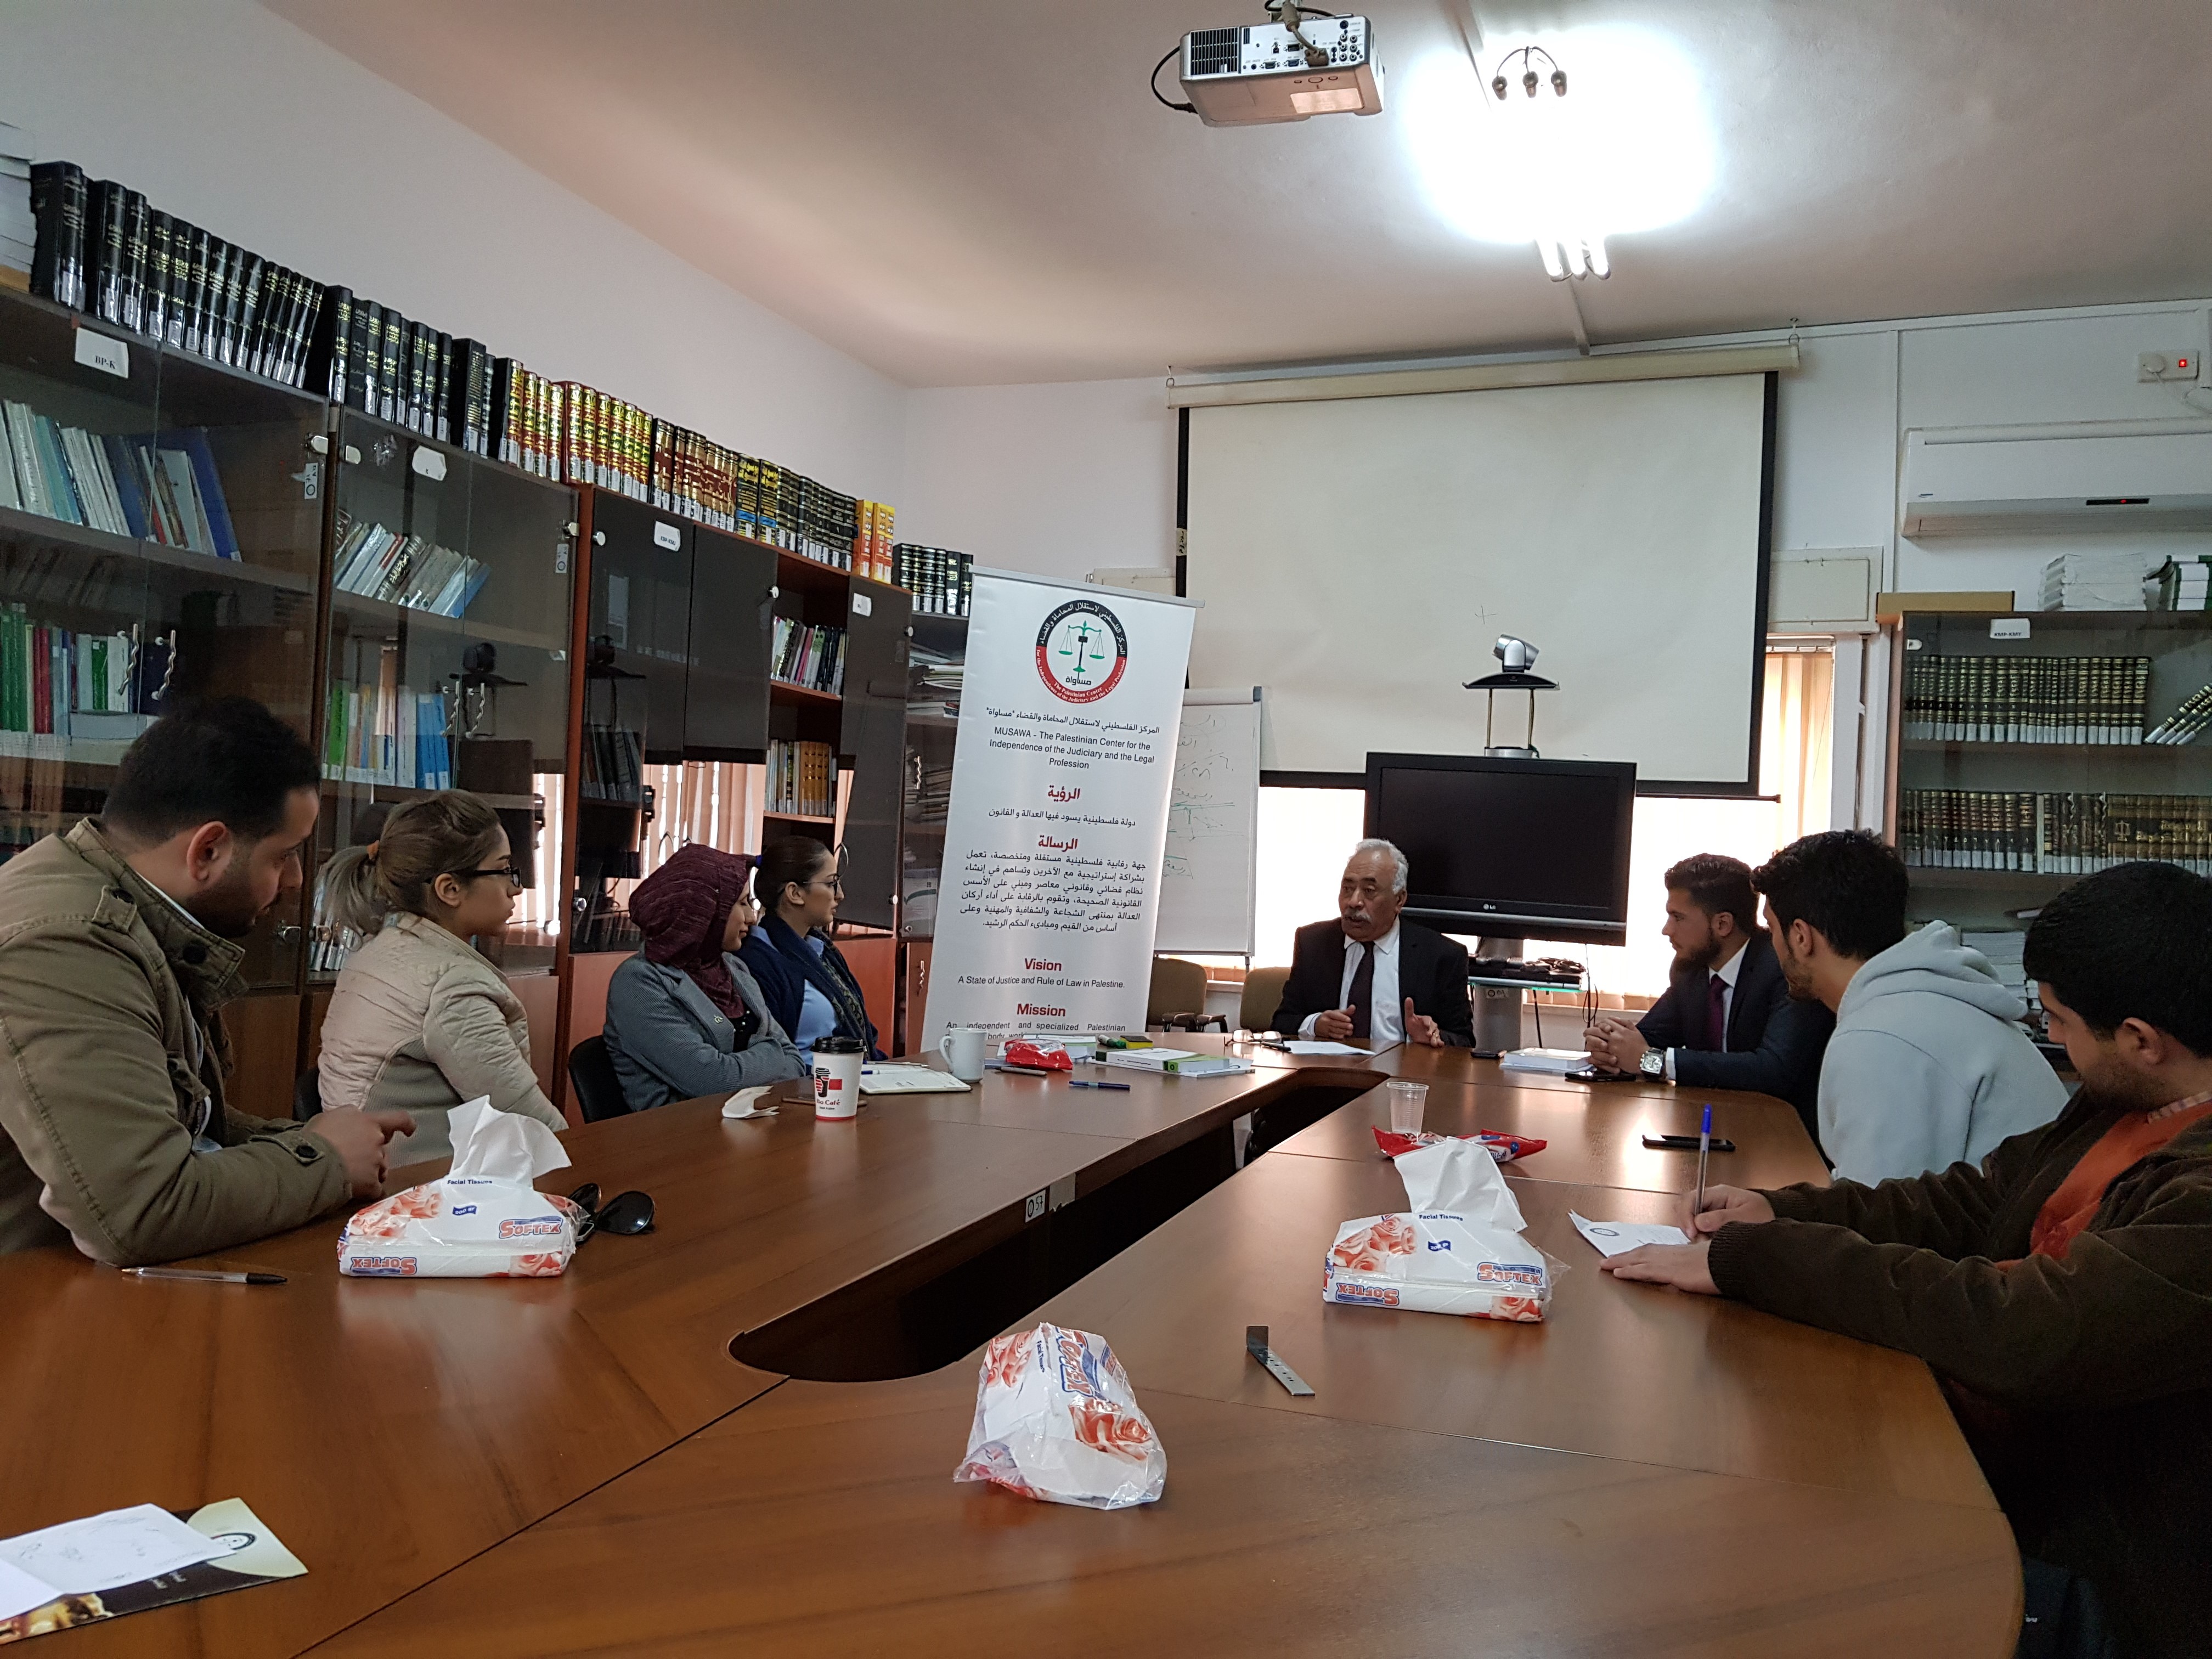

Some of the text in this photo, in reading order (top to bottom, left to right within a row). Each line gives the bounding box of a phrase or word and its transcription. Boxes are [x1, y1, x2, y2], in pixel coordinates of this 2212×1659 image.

[95, 356, 115, 369] BP-K
[1065, 676, 1091, 685] مساواة
[1017, 712, 1041, 722] والقضاء
[1043, 714, 1068, 723] المحاماة
[1069, 716, 1100, 726] لاستقلال
[1102, 721, 1137, 731] الفلسطيني
[1138, 726, 1159, 734] المركز
[995, 726, 1031, 737] MUSAWA
[1040, 731, 1053, 740] The
[1056, 733, 1097, 744] Palestinian
[1100, 738, 1125, 747] Center
[990, 739, 1042, 752] Independence
[1067, 747, 1102, 759] Judiciary
[1135, 754, 1154, 764] Legal
[1049, 758, 1089, 769] Profession
[1048, 785, 1080, 802] الرؤية
[989, 808, 1014, 817] القانون
[1022, 810, 1043, 818] العدالة
[1046, 811, 1058, 821] فيها
[1061, 815, 1081, 823] يسود
[1084, 815, 1119, 825] فلسطينية
[1121, 818, 1136, 827] دولة
[1039, 835, 1077, 852] الرسالة
[967, 850, 986, 859] تعمل
[1035, 854, 1061, 862] مستقلة
[1066, 856, 1102, 866] فلسطينية
[1107, 860, 1127, 869] رقابية
[1132, 861, 1146, 871] جهة
[965, 863, 985, 873] إنشاء
[989, 865, 1000, 876] في
[1003, 866, 1030, 876] وتساهم
[1034, 867, 1060, 876] الآخرين
[1119, 873, 1144, 883] بشراكة
[963, 876, 1143, 897] نظام قضائي وقانوني معاصر ومبني على الأسس
[962, 889, 983, 900] أركان
[986, 890, 998, 899] أداء
[1001, 892, 1014, 901] على
[1018, 893, 1043, 902] بالرقابة
[1047, 895, 1069, 904] وتقوم
[961, 904, 980, 913] وعلى
[1112, 899, 1142, 908] القانونية
[985, 905, 1012, 915] والمهنية
[1016, 906, 1049, 916] والشفافية
[1054, 908, 1085, 918] الشجاعة
[1089, 912, 1113, 921] بمنتهى
[1009, 919, 1029, 929] الحكم
[1060, 922, 1081, 931] القيم
[1096, 923, 1117, 933] أساس
[1025, 958, 1062, 971] Vision
[1092, 980, 1125, 988] Palestine.
[1017, 1003, 1065, 1017] Mission
[499, 1218, 562, 1239] SOFTEX
[351, 1257, 417, 1276] SOFTEX
[1477, 1263, 1542, 1285] SOFTEX
[1336, 1283, 1400, 1306] SOFTEX
